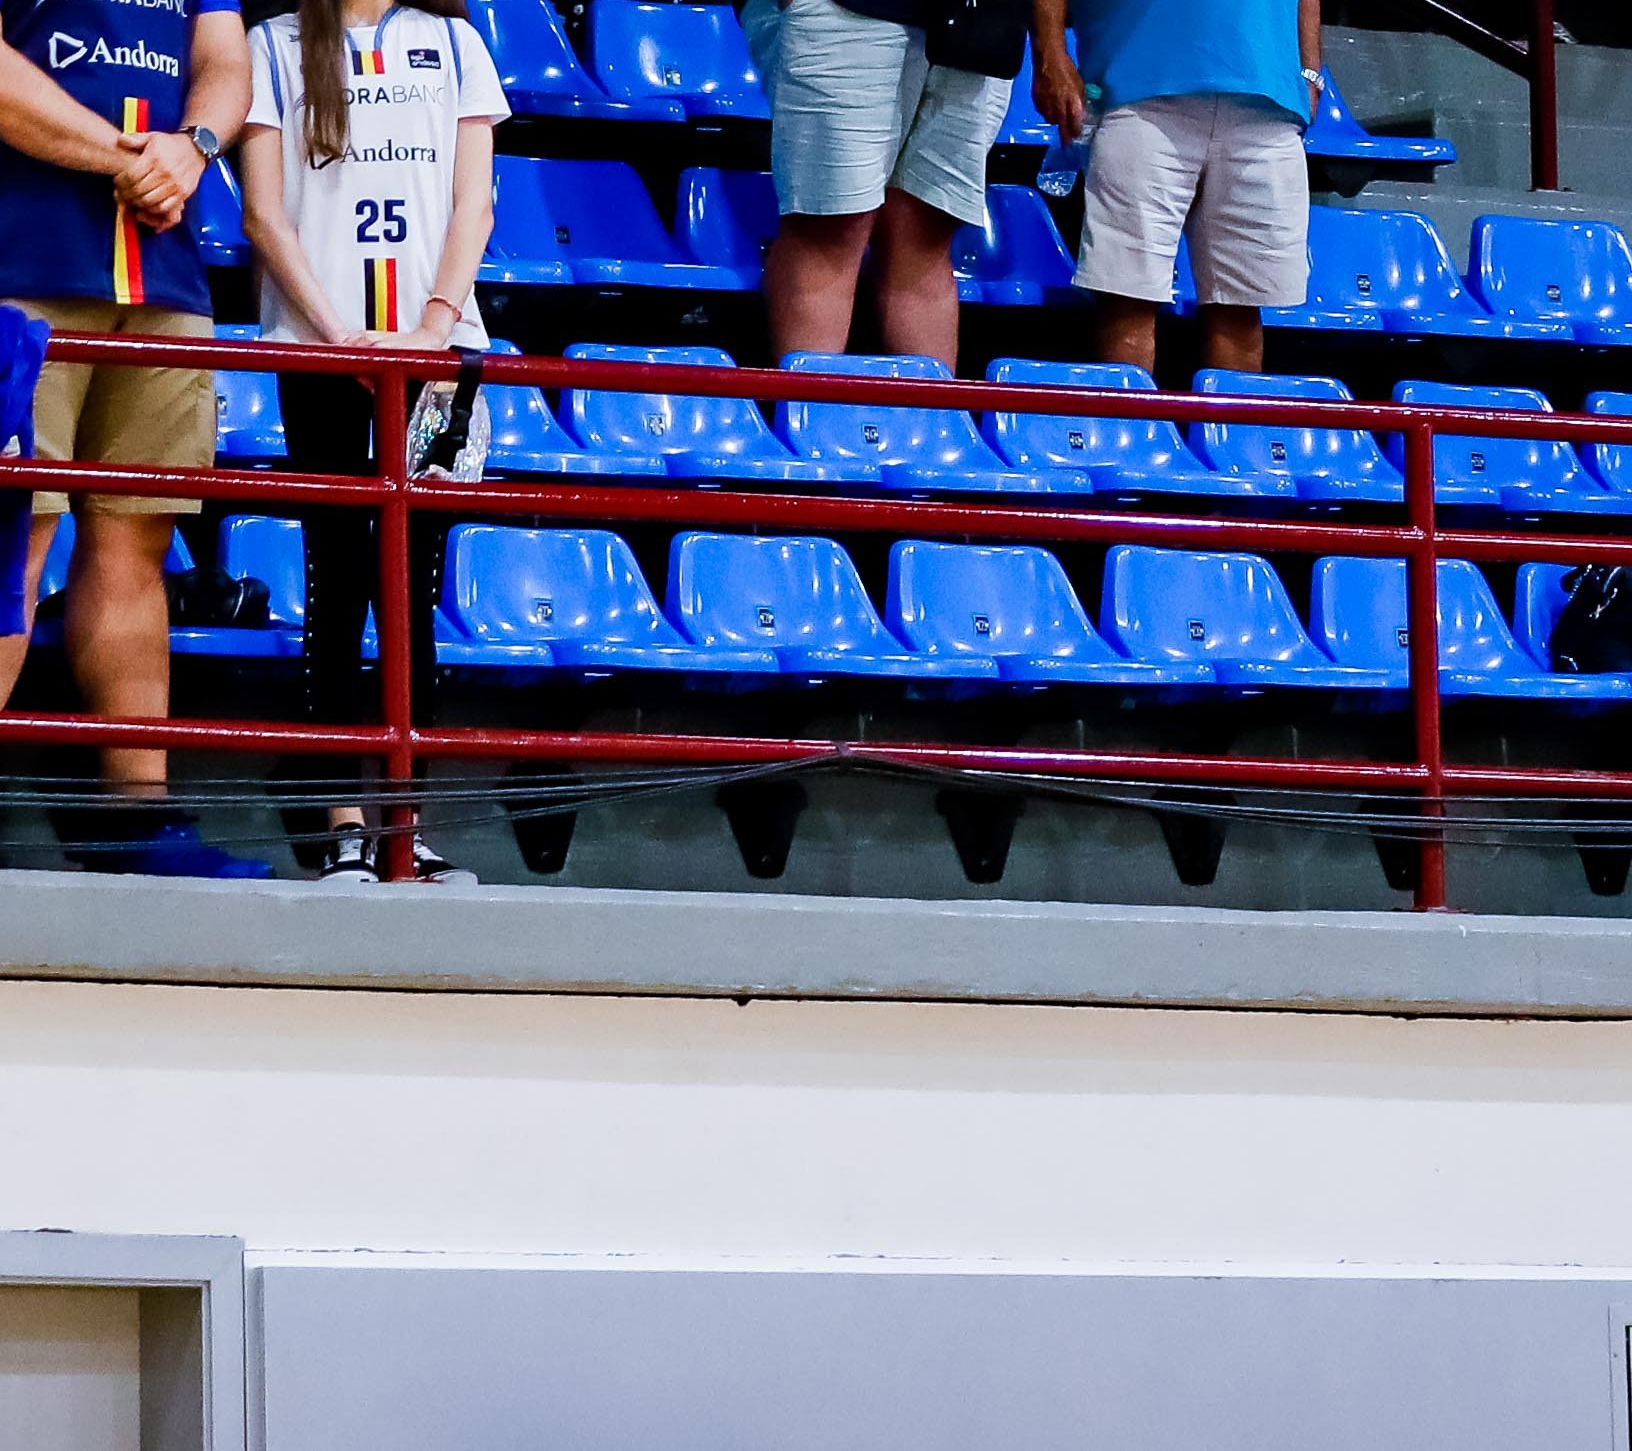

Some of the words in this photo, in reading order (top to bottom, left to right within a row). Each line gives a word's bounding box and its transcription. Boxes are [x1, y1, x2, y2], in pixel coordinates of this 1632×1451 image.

[87, 36, 180, 78] Andorra
[344, 83, 446, 107] ORABANC
[340, 138, 437, 164] Andorra
[354, 198, 408, 244] 25
